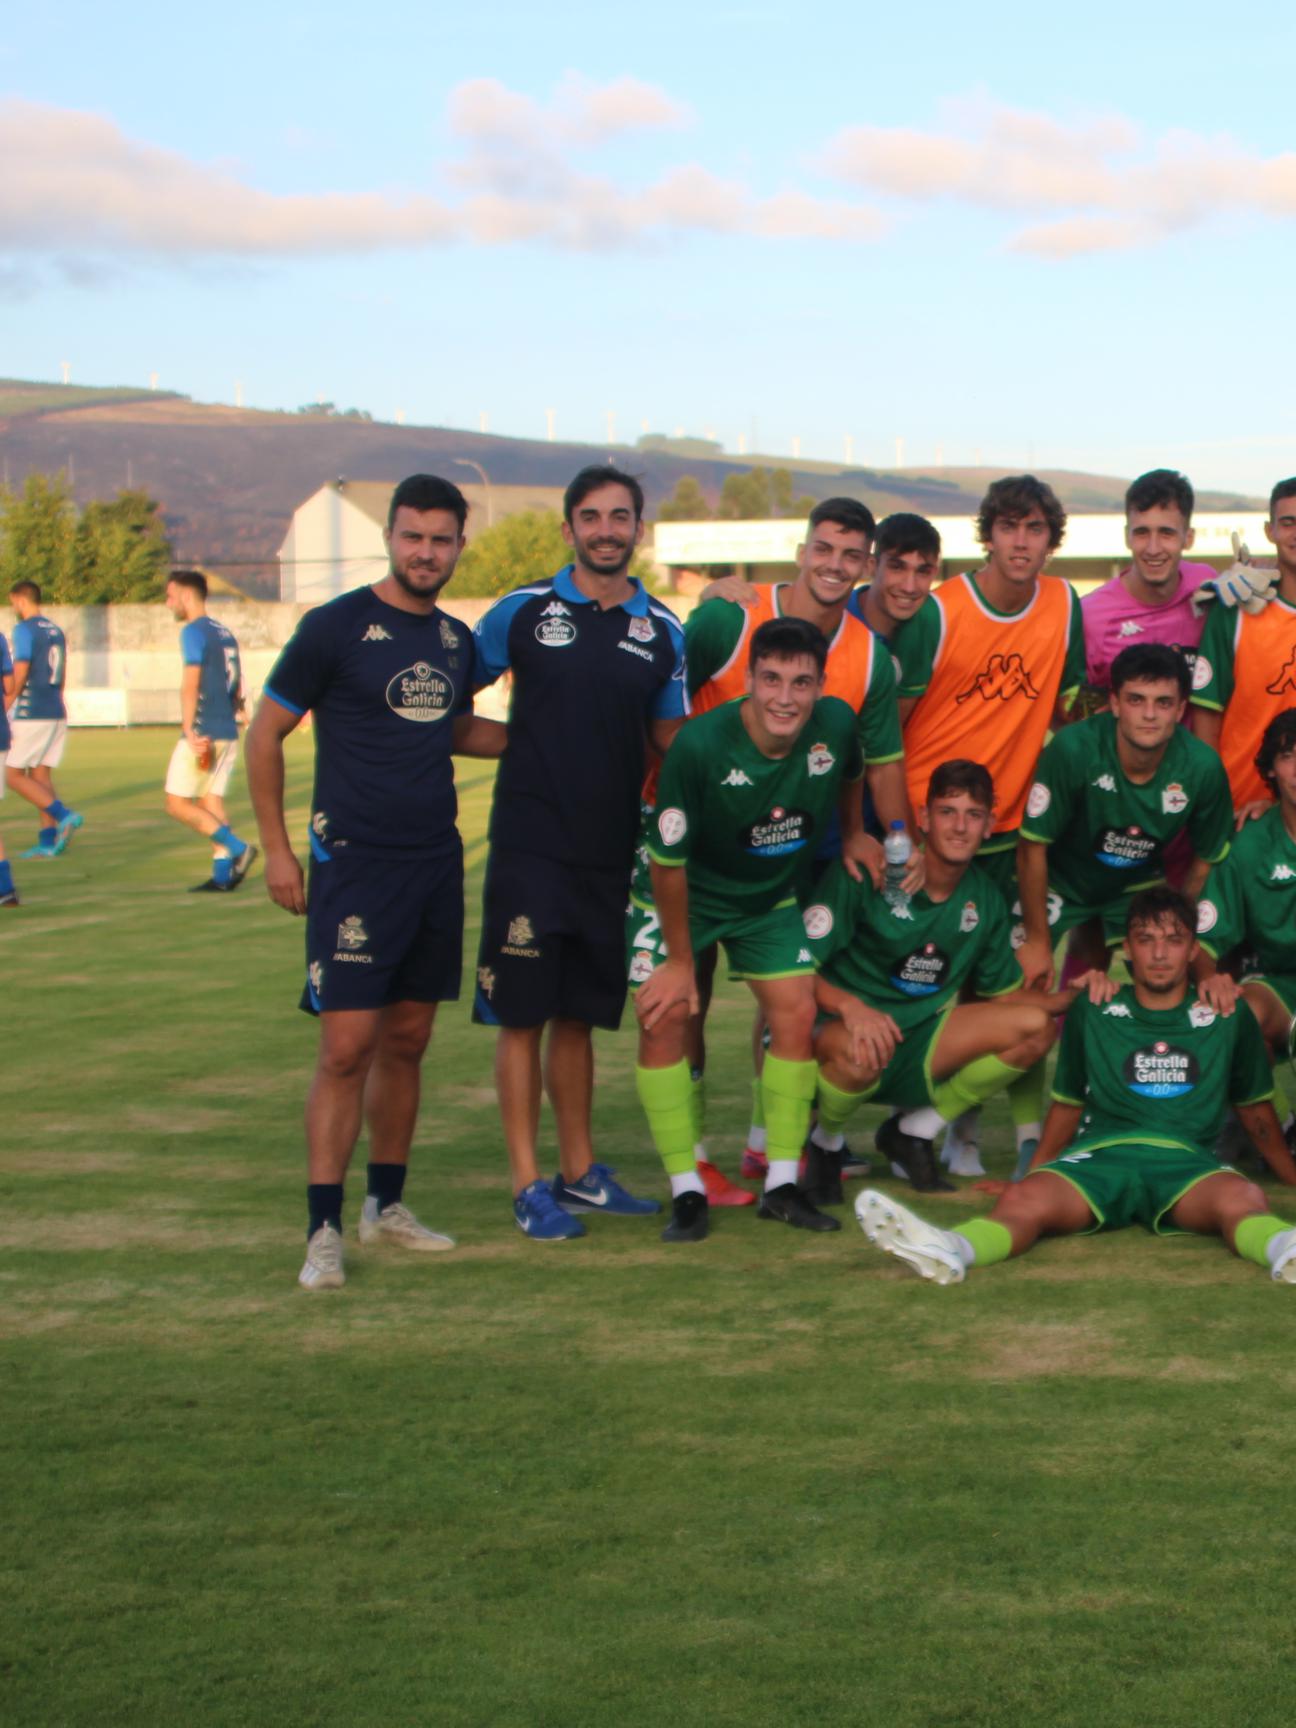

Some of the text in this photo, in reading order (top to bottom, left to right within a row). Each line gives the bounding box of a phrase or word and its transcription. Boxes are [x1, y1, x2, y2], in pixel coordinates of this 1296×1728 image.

[618, 641, 654, 662] ABANCA
[48, 645, 62, 685] 9
[223, 647, 239, 693] 5
[401, 678, 446, 693] Estrella
[402, 692, 444, 706] Galicia
[751, 815, 803, 837] Estrella
[751, 828, 800, 847] Galicia
[1103, 831, 1155, 851] Estrella
[1103, 841, 1149, 859] Galicia
[333, 952, 373, 964] ABANCA
[501, 945, 541, 958] ABANCA
[905, 955, 944, 971] Estrella
[900, 968, 936, 984] Galicia
[1134, 1053, 1189, 1068] Estrella
[1135, 1068, 1187, 1083] Galicia
